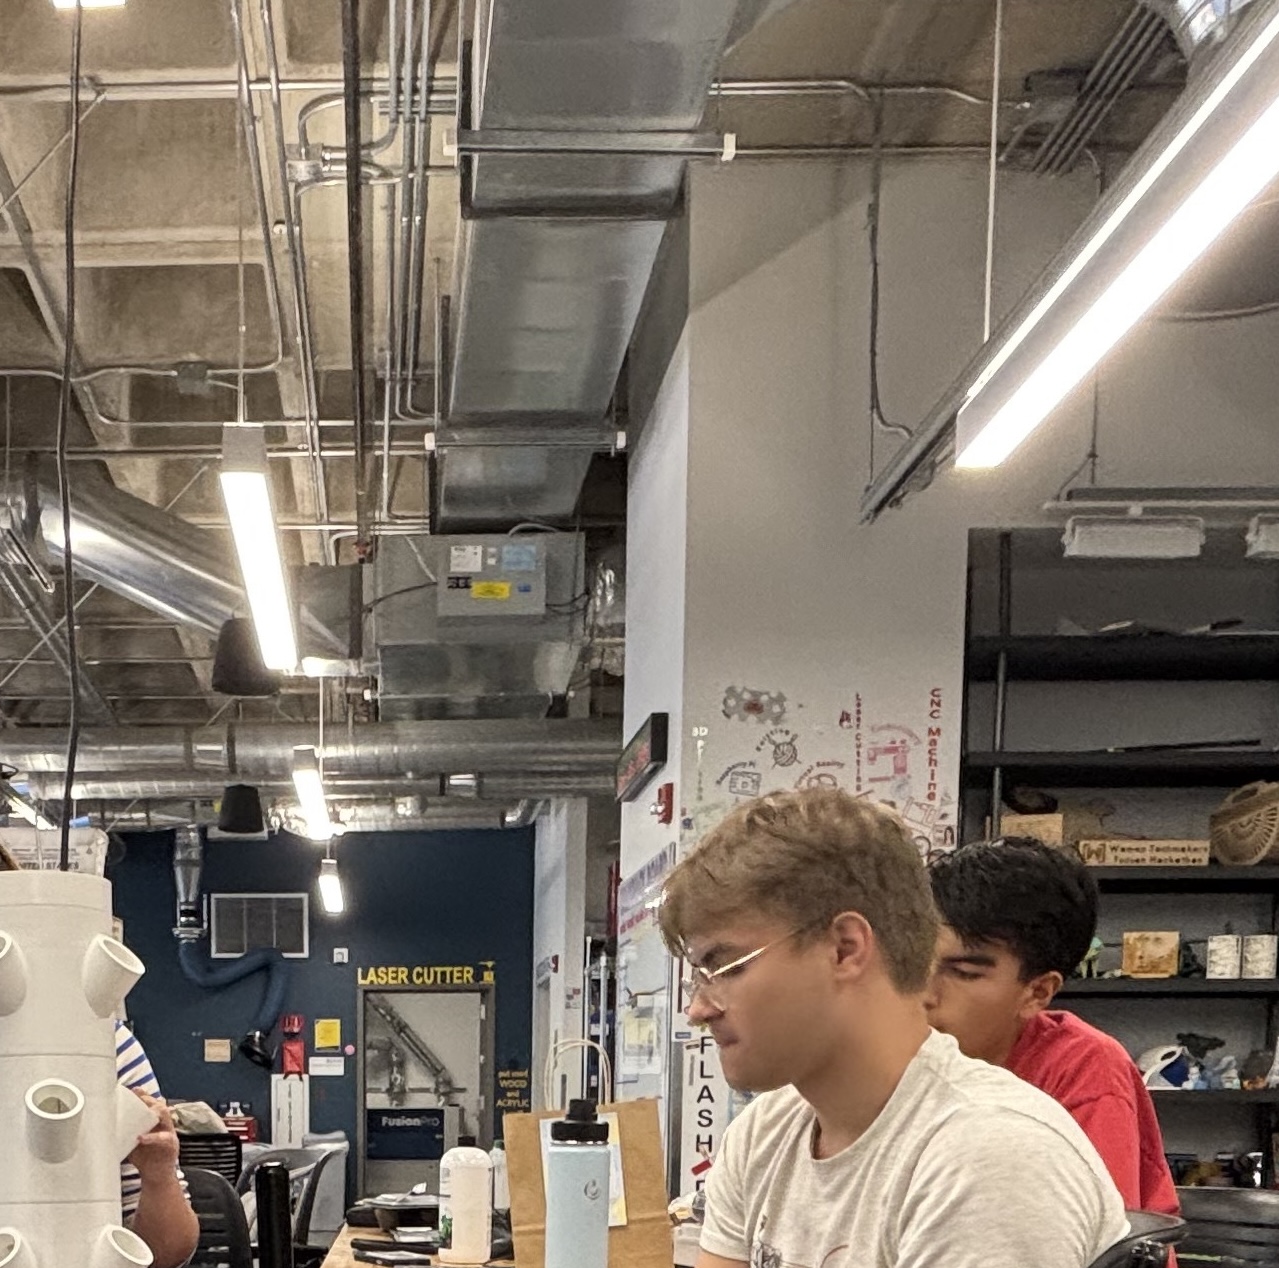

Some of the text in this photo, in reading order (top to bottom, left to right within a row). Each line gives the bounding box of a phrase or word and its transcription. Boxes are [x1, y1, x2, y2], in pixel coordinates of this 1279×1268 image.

[929, 688, 942, 719] CNC
[357, 966, 474, 985] LASER CUTTER
[696, 1036, 715, 1153] FLASH
